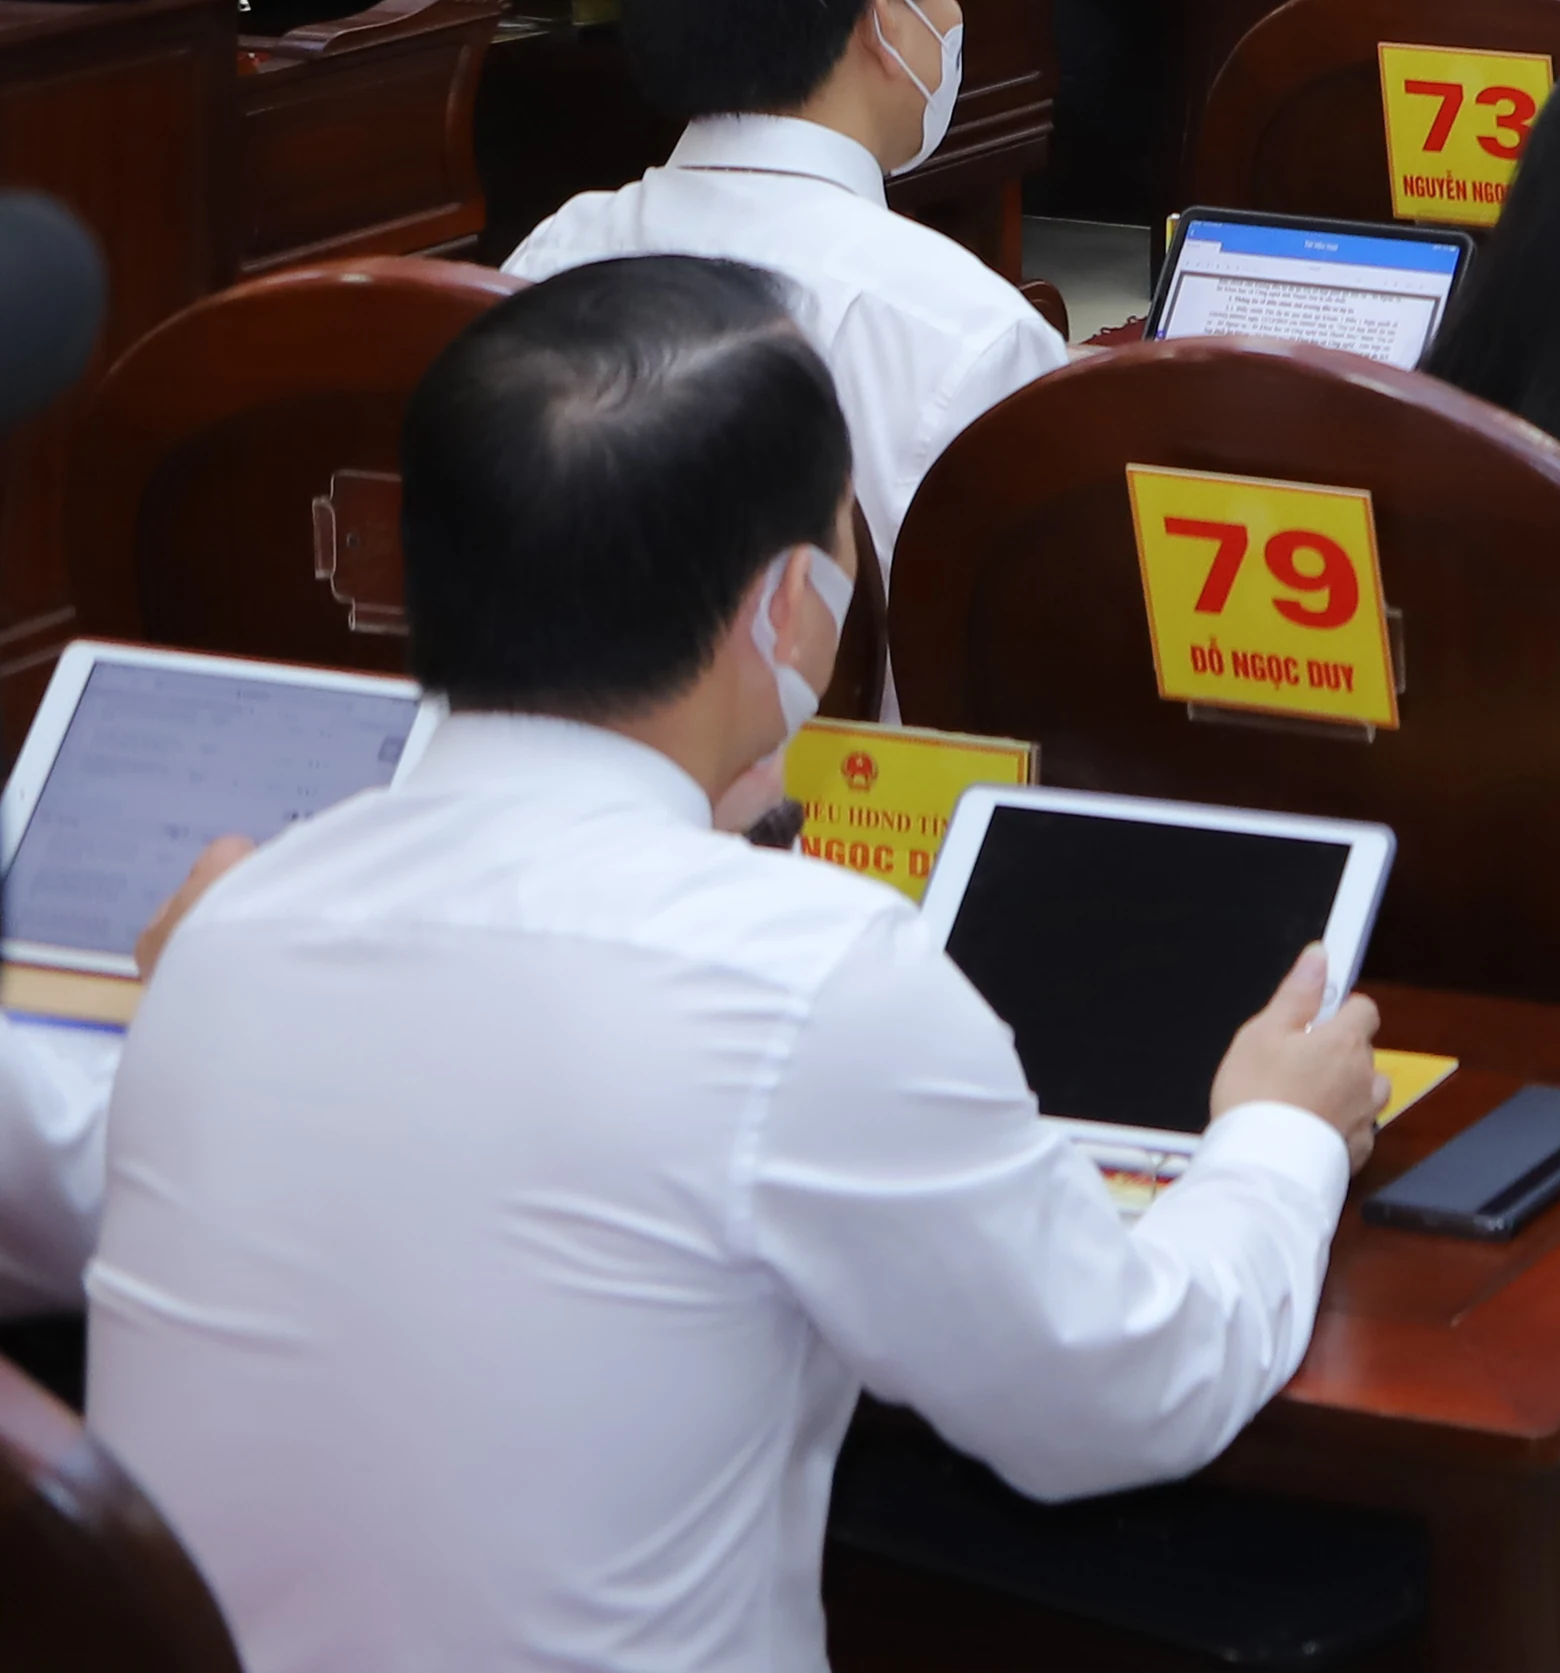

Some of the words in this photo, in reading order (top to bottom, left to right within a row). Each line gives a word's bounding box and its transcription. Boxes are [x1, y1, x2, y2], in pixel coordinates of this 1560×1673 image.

[1404, 79, 1538, 161] 73
[1402, 169, 1467, 202] NGUYỄN
[1163, 516, 1361, 632] 79
[1189, 636, 1225, 677] ĐỖ
[1232, 651, 1300, 692] NGỌC
[1308, 658, 1357, 695] DUY
